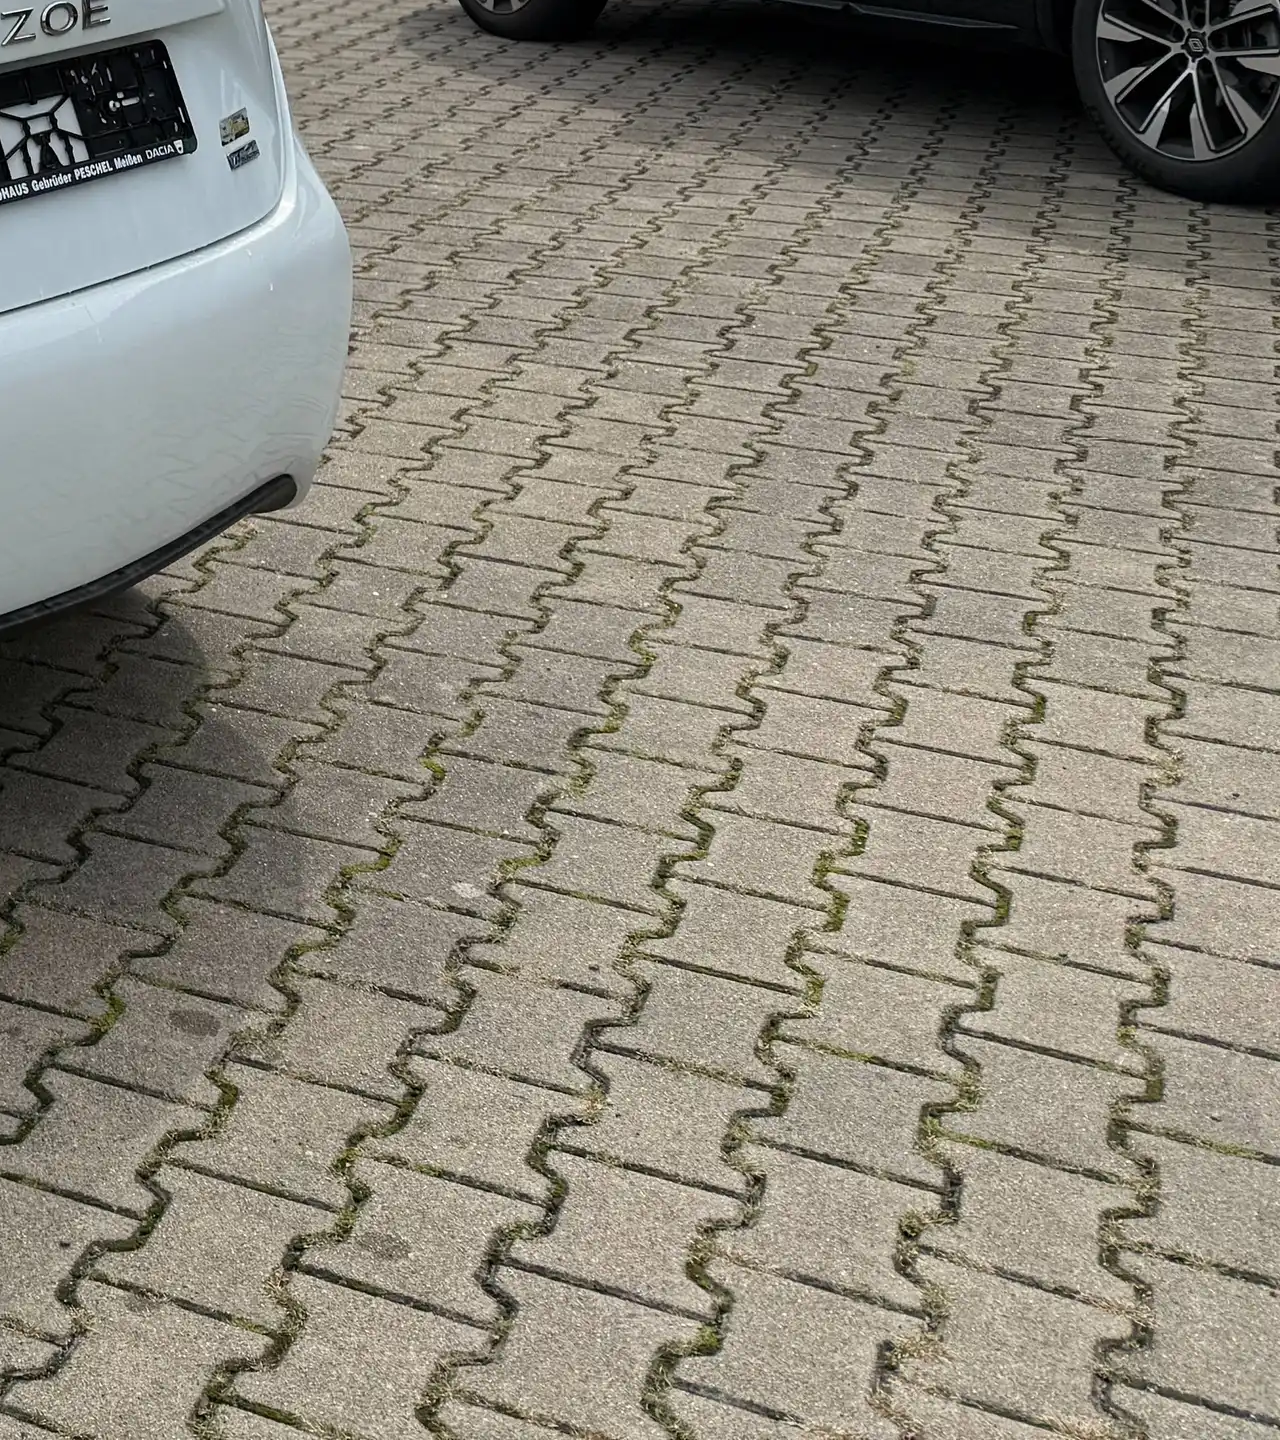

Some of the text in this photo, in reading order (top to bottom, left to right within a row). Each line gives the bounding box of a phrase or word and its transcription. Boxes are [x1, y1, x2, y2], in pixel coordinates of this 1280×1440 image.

[31, 172, 72, 191] Gebrüder
[73, 160, 114, 181] PESCHEL
[113, 154, 143, 170] Meißen
[145, 144, 175, 160] DACIA
